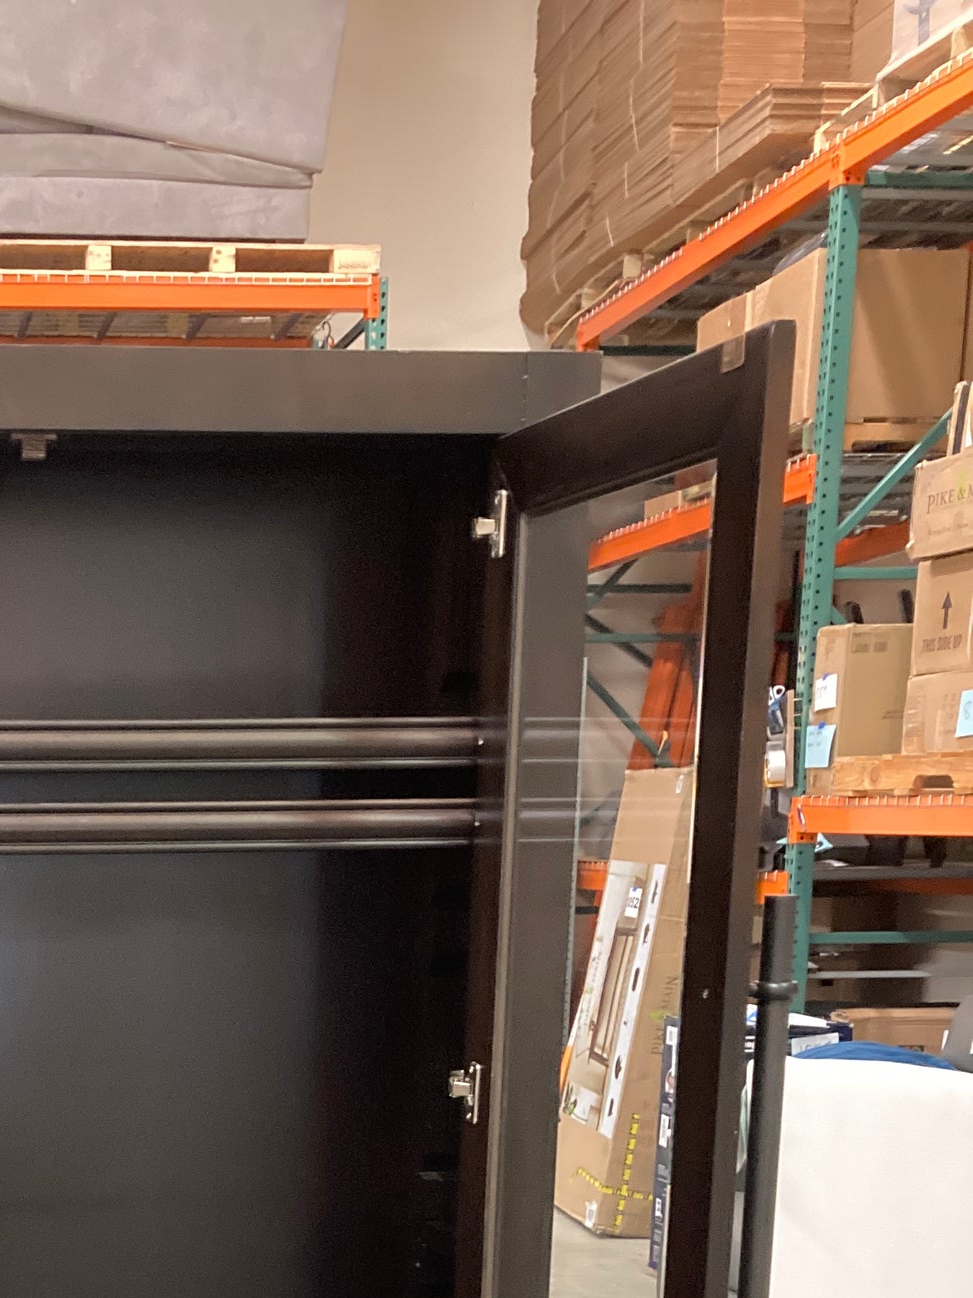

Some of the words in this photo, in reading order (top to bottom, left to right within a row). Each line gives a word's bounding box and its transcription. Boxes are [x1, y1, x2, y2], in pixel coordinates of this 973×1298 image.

[926, 488, 955, 514] PIKE
[957, 486, 966, 501] &
[922, 638, 936, 652] THIS
[937, 636, 951, 651] SIDE
[953, 634, 963, 649] UP
